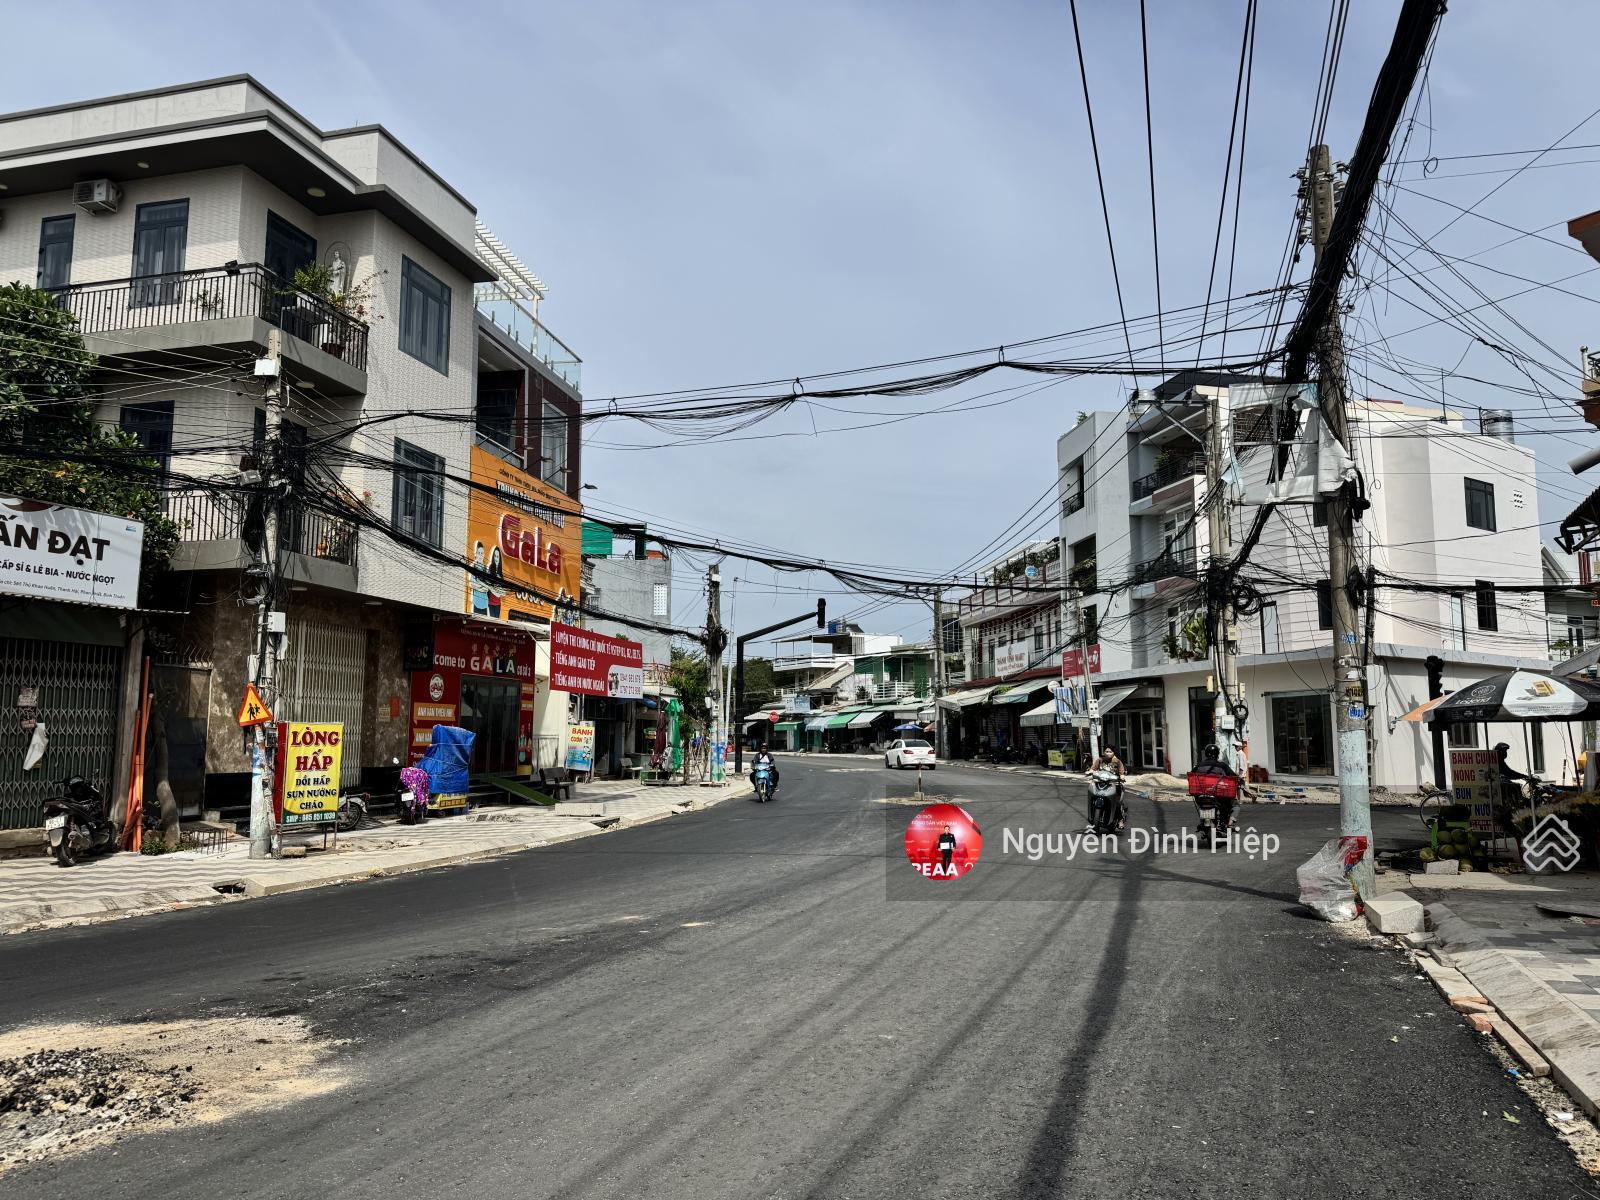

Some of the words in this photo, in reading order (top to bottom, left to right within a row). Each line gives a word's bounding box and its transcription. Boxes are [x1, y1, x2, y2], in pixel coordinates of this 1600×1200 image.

[47, 529, 111, 566] ĐẠT
[25, 564, 32, 573] &
[45, 567, 59, 577] BIA
[66, 570, 91, 581] NƯỚC
[92, 573, 116, 586] NGỌT
[456, 655, 466, 668] to
[470, 656, 516, 674] GALA
[555, 650, 567, 666] TIẾNG
[567, 653, 577, 668] ANH
[555, 671, 567, 687] TIẾNG
[567, 674, 577, 688] ANH
[292, 727, 340, 746] LÒNG
[295, 749, 333, 771] HẤP
[313, 774, 331, 786] HẤP
[286, 789, 305, 801] SỤN
[306, 786, 337, 799] NƯỚNG
[1455, 785, 1473, 800] BÚN
[299, 799, 324, 810] CHÁO
[285, 815, 299, 824] SHIP
